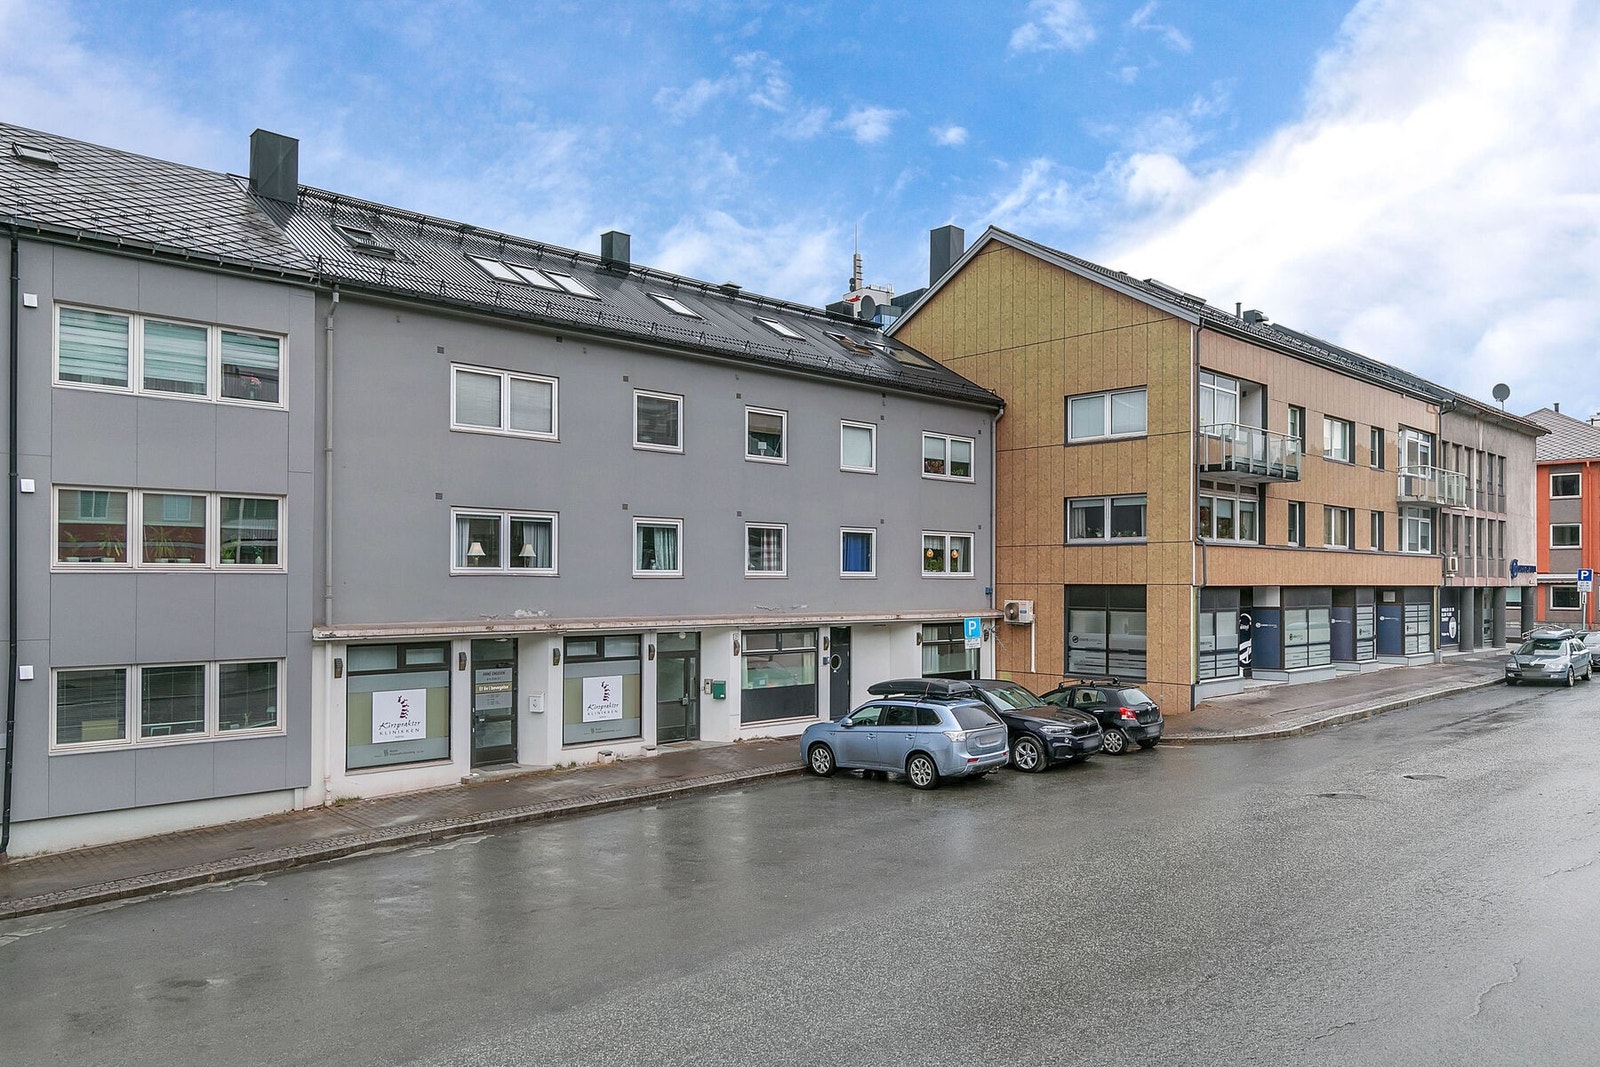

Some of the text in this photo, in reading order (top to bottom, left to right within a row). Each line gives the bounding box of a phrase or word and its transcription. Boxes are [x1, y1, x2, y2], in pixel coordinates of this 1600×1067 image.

[1581, 570, 1589, 580] P
[968, 620, 977, 636] P
[379, 720, 420, 730] Kiropraktor
